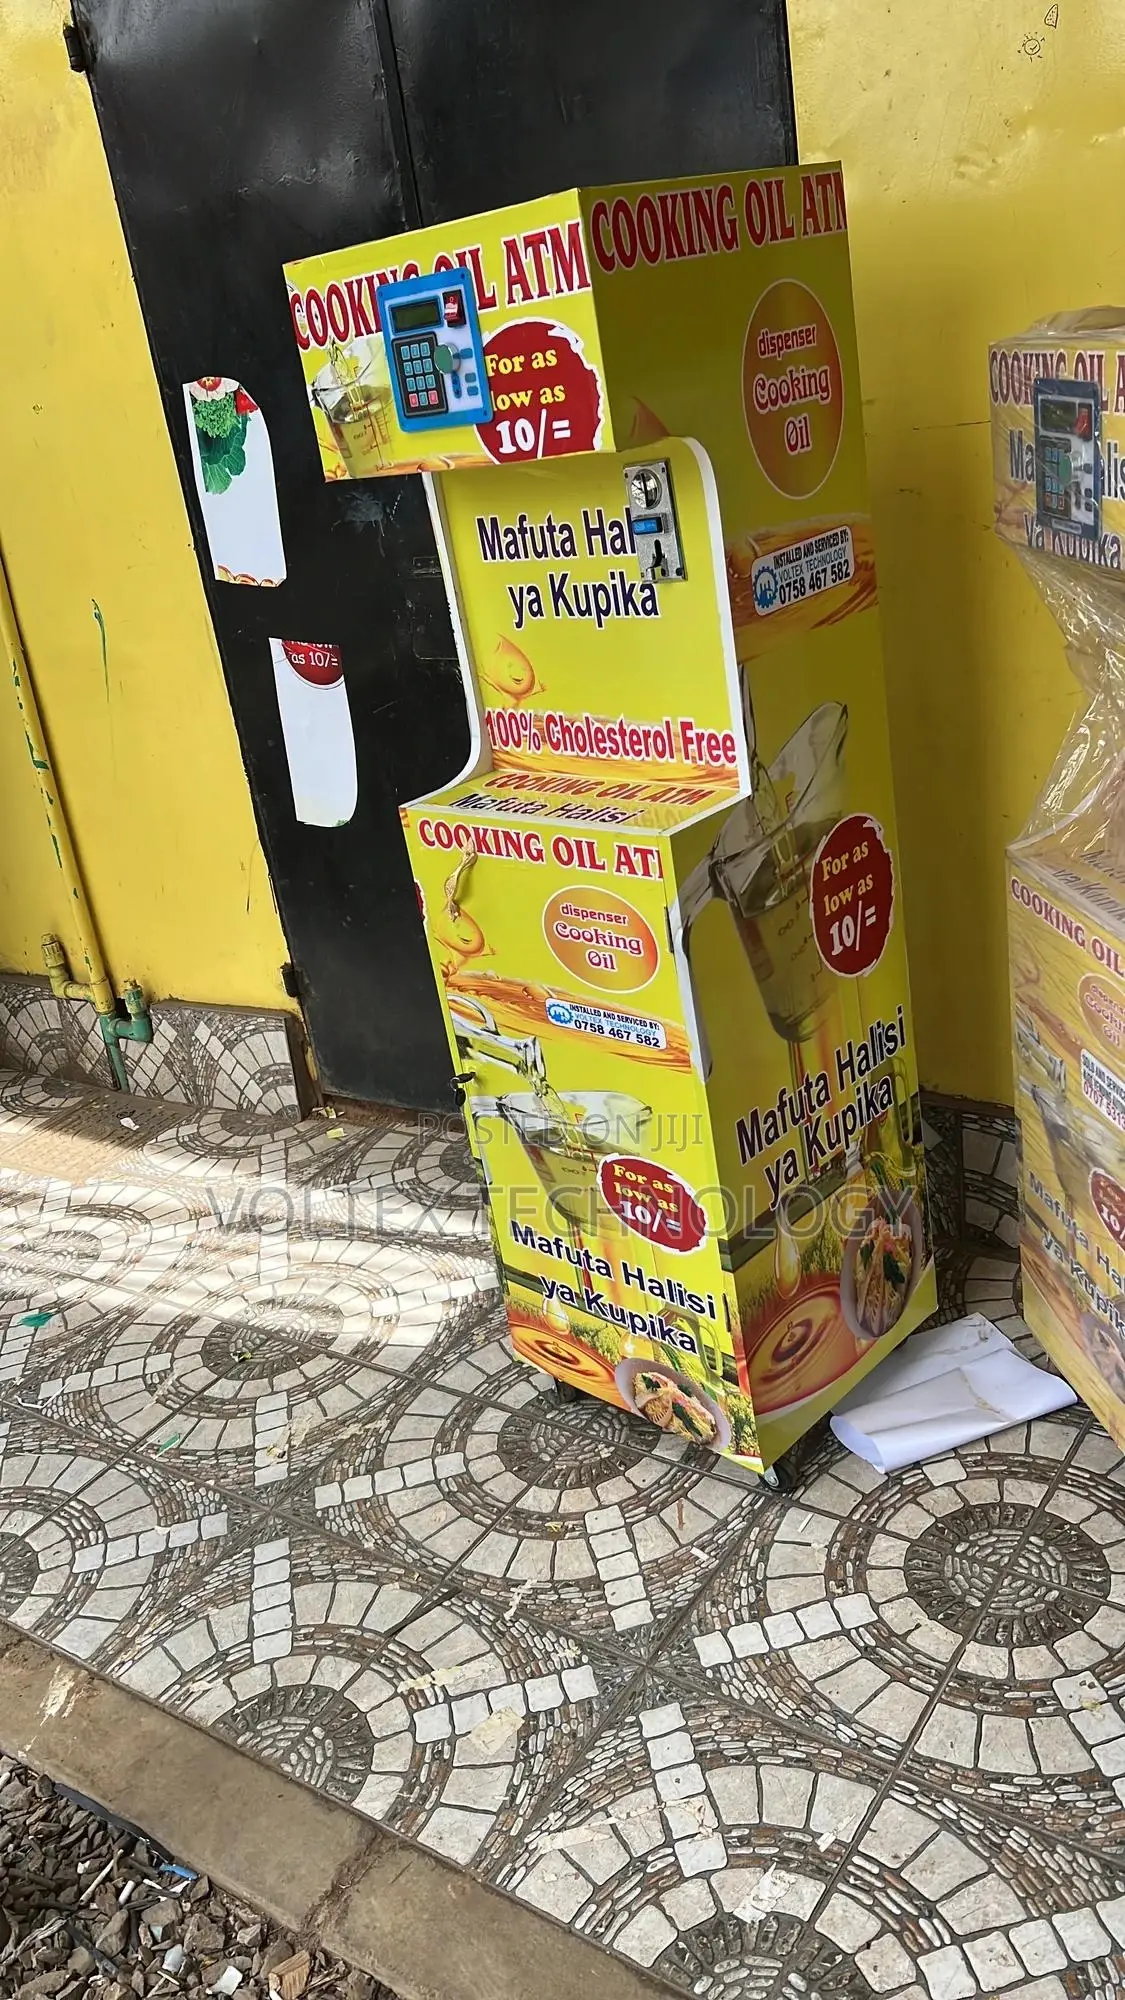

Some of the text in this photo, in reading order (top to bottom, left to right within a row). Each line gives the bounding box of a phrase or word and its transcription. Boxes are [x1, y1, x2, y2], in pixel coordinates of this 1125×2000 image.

[591, 185, 739, 272] COOKING
[745, 180, 795, 246] OIL
[291, 263, 418, 350] COOKI
[503, 222, 591, 304] ATM
[486, 349, 558, 377] For as
[759, 326, 817, 358] dispenser
[540, 384, 566, 405] as
[755, 368, 830, 411] Cooking
[496, 408, 571, 460] 10/=
[786, 416, 811, 453] Oil
[477, 507, 637, 561] Mafuta Hal
[773, 528, 849, 570] INSTALLED AND SERVICED BY:
[779, 546, 848, 583] VOLTEX TECHNOLOGY
[780, 559, 850, 605] 0758 467 582
[507, 571, 659, 630] ya Kupika
[291, 653, 306, 665] as
[486, 710, 737, 764] 100% Cholesterol Free
[450, 793, 646, 825] Mafuta Halisi
[486, 773, 717, 806] COOKING OIL ATM
[419, 819, 664, 879] COOKING OIL AT
[821, 840, 869, 882] For as
[561, 904, 628, 926] dispenser
[823, 873, 874, 917] low as
[555, 923, 642, 955] Cooking
[829, 900, 877, 956] 10/=
[1011, 878, 1087, 950] COOKING
[1092, 938, 1125, 978] OIL
[588, 950, 616, 971] Oil
[569, 1004, 660, 1031] INSTALLED AND SERVICED BY:
[574, 1013, 657, 1037] VOLTEX TECHNOLOGY
[574, 1020, 661, 1048] 0758 467 582
[736, 1005, 906, 1165] Mafuta Halisi
[764, 1076, 893, 1210] ya Kupika
[612, 1163, 674, 1194] For as
[613, 1181, 679, 1213] low as
[620, 1200, 682, 1233] 10/=
[511, 1220, 717, 1320] Mafuta Halisi
[541, 1275, 698, 1355] ya Kupika
[1070, 1261, 1125, 1339] Kupik
